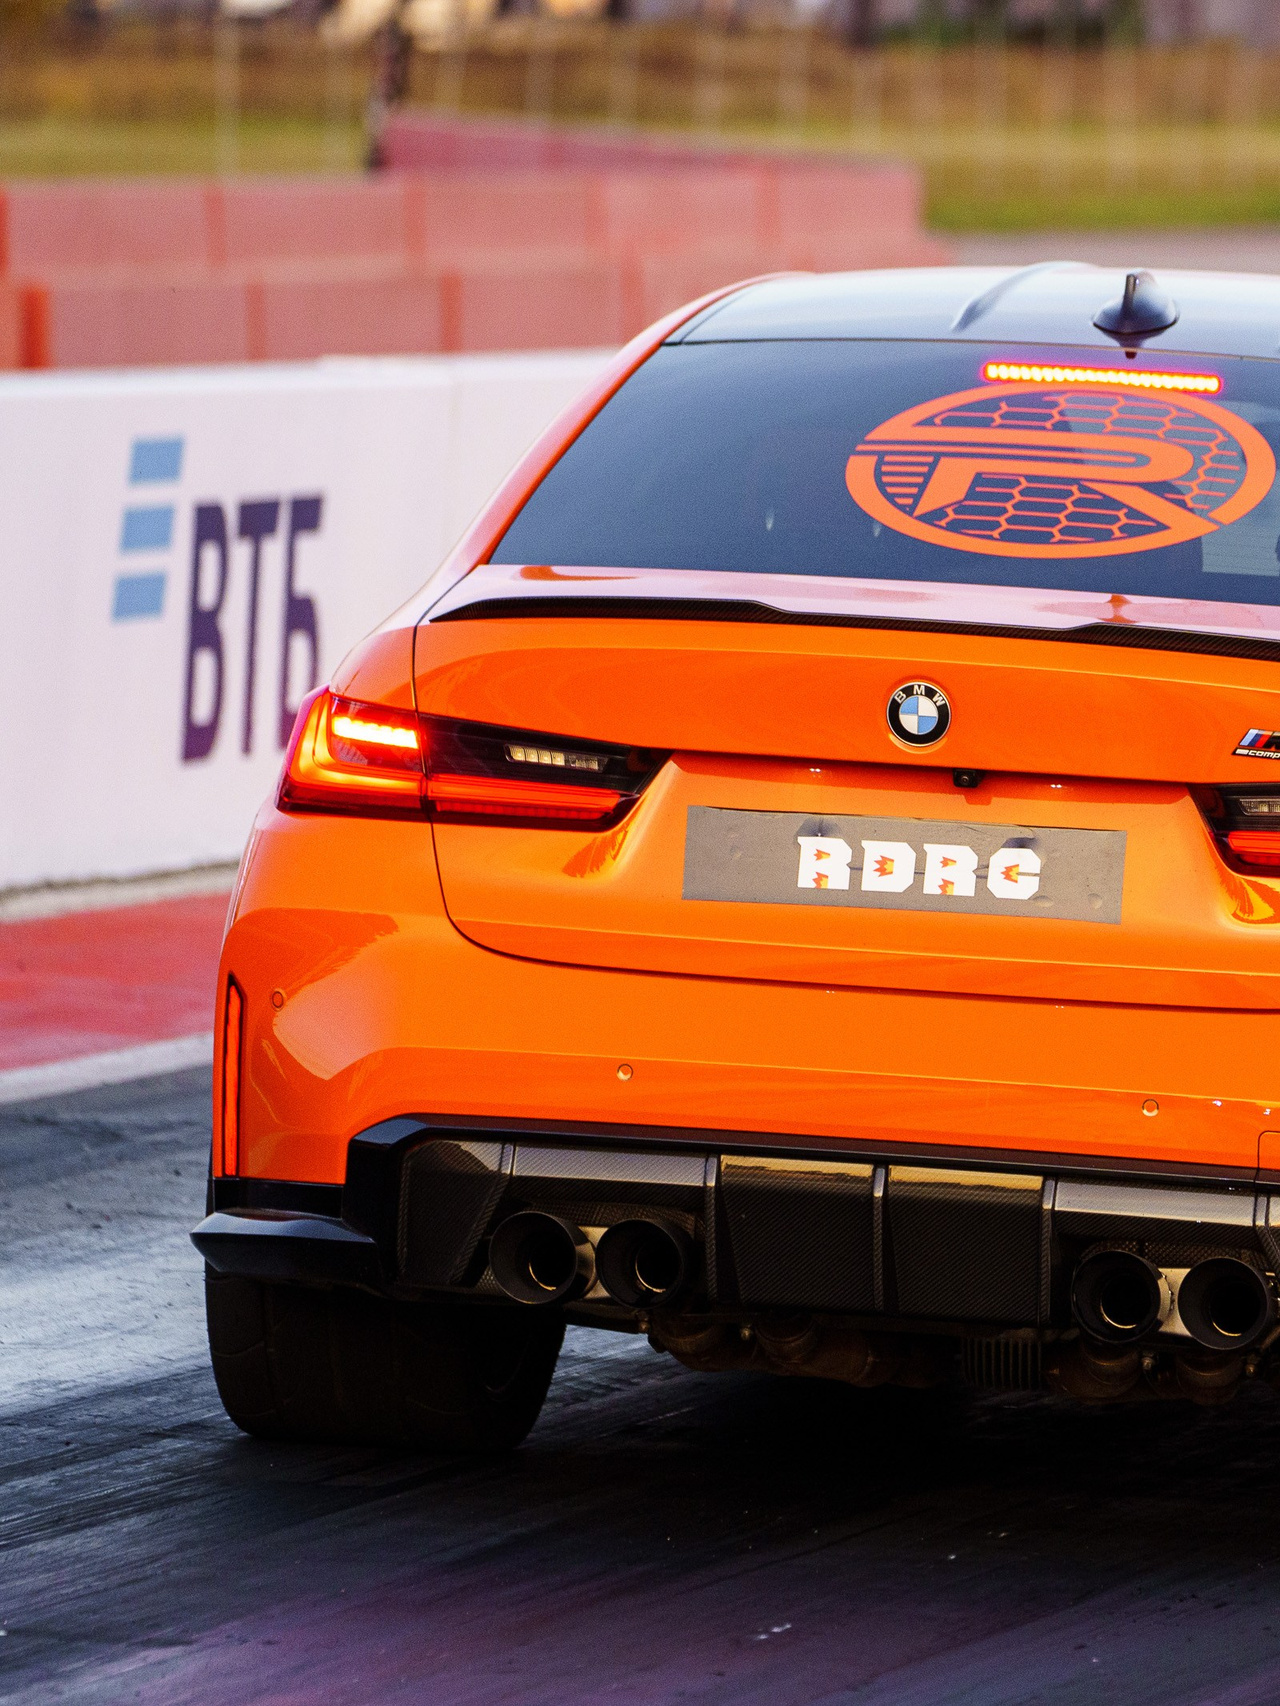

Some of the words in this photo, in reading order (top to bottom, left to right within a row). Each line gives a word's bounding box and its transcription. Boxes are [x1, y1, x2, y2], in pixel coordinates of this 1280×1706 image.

[181, 494, 322, 764] ВТБ
[894, 684, 946, 707] BMW
[797, 836, 1041, 900] RDRC
